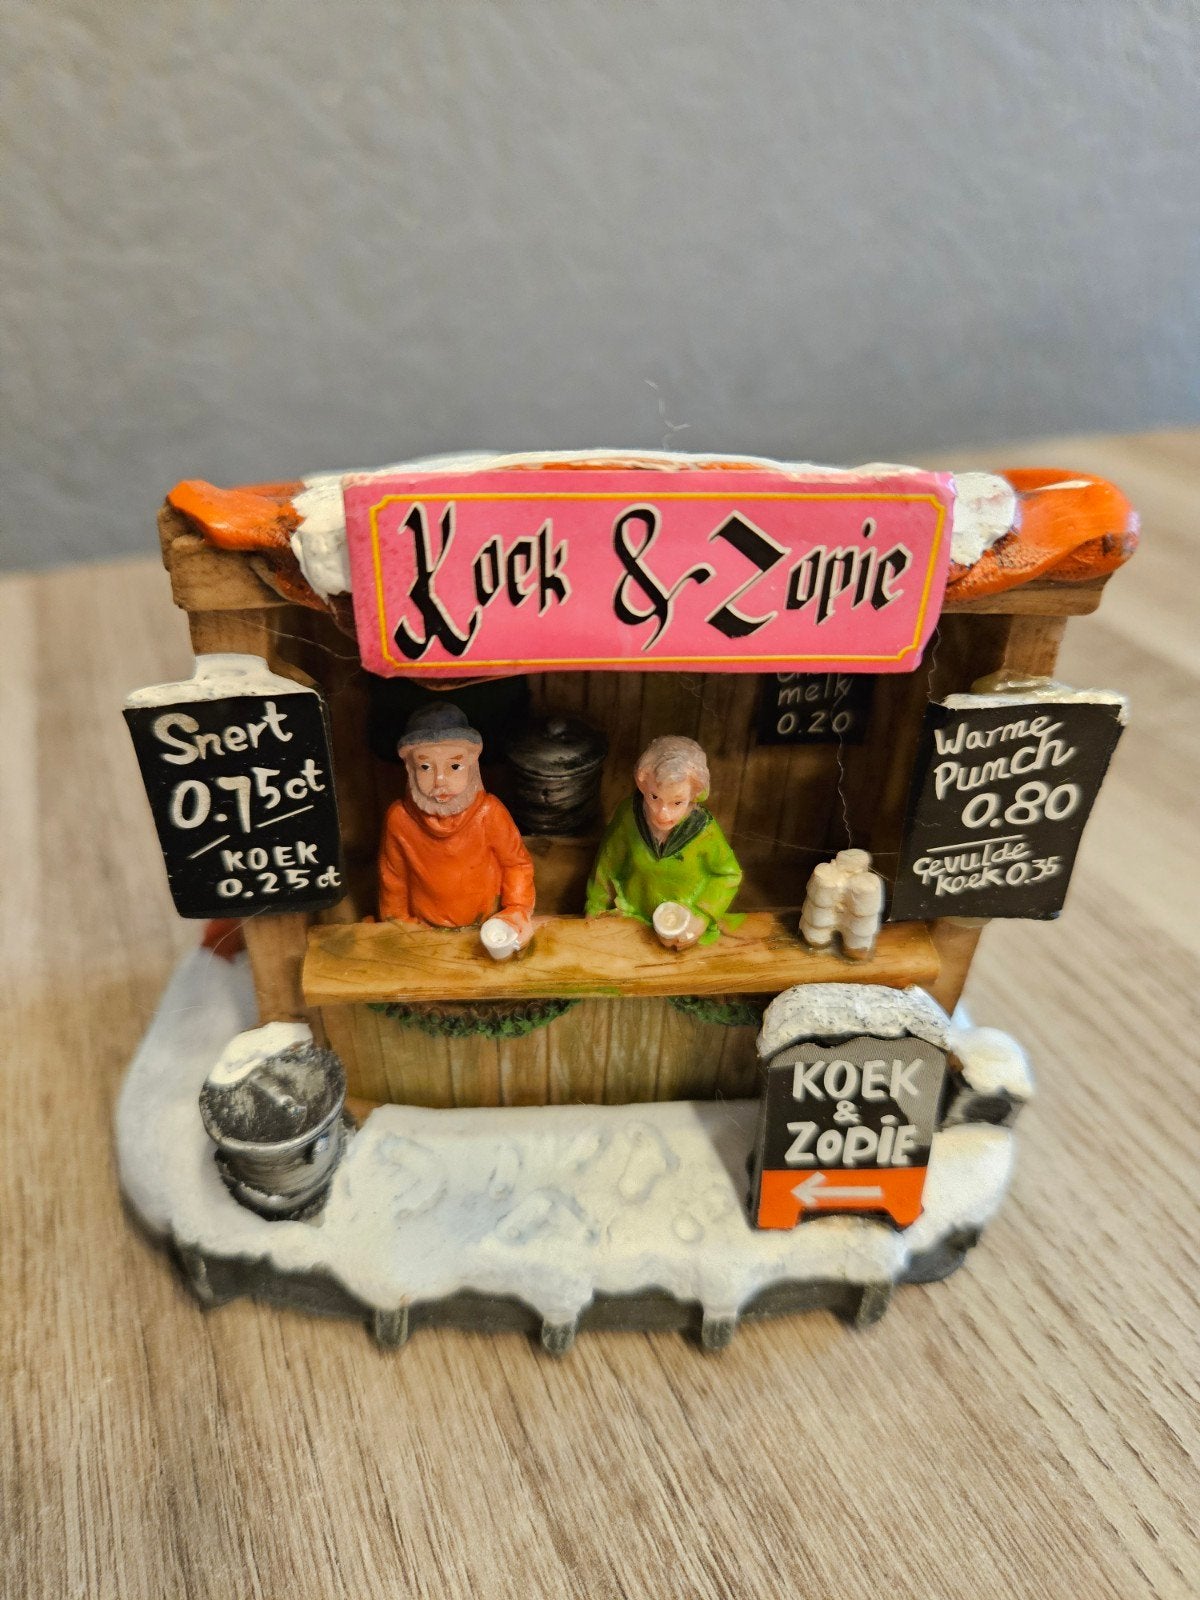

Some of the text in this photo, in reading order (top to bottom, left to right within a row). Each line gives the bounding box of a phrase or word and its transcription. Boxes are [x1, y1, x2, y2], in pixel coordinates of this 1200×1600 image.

[393, 501, 912, 660] Koek & Zopie
[153, 701, 294, 765] Snert
[776, 711, 851, 735] 0.20
[934, 715, 1066, 756] Warme
[933, 736, 1078, 801] Punch
[961, 780, 1084, 829] 0.80
[220, 840, 320, 873] KOEK
[935, 855, 1065, 897] koek 0.35
[791, 1058, 925, 1101] KOEK
[832, 1099, 864, 1127] &
